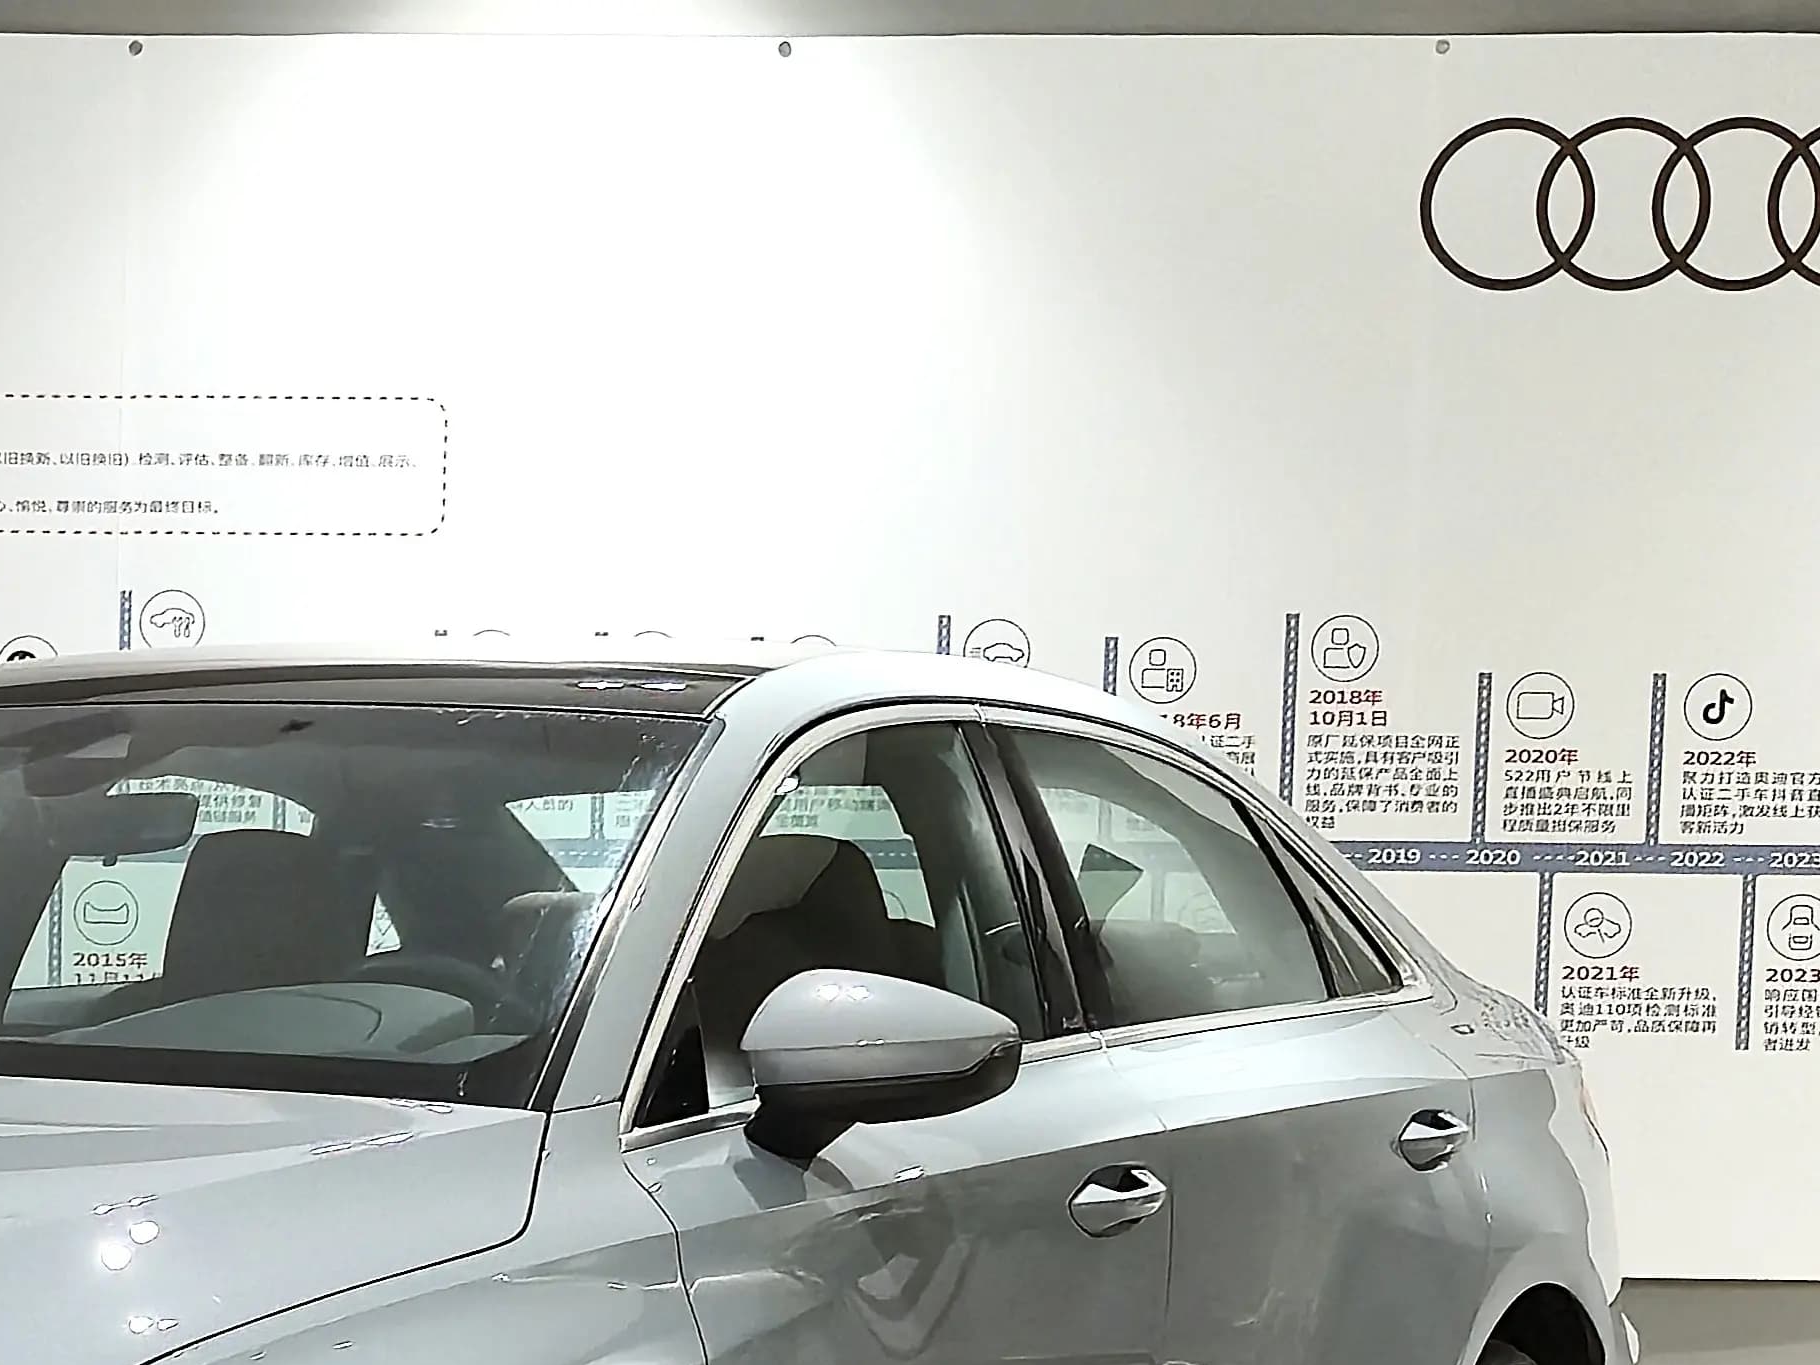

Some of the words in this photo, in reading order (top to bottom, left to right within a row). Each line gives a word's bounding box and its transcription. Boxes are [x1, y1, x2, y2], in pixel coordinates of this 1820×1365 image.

[1309, 690, 1383, 706] 2018年
[1159, 711, 1243, 730] 8年6月
[1310, 710, 1387, 727] 10月1日
[1505, 748, 1579, 766] 2020年
[1683, 751, 1756, 768] 2022年
[1503, 802, 1630, 816] 步推出2年不限里
[1503, 819, 1616, 833] 程质量担保服务
[1680, 821, 1744, 834] 客新活力
[1368, 849, 1421, 865] 2019
[1465, 849, 1521, 866] 2020
[1574, 850, 1630, 867] 2021
[1669, 851, 1725, 868] 2022
[1769, 852, 1820, 869] 2023
[73, 953, 148, 969] 2015年
[1562, 966, 1640, 983] 2021年
[1766, 968, 1820, 983] 2023
[1560, 1000, 1716, 1017] 奥迪110项检测标准
